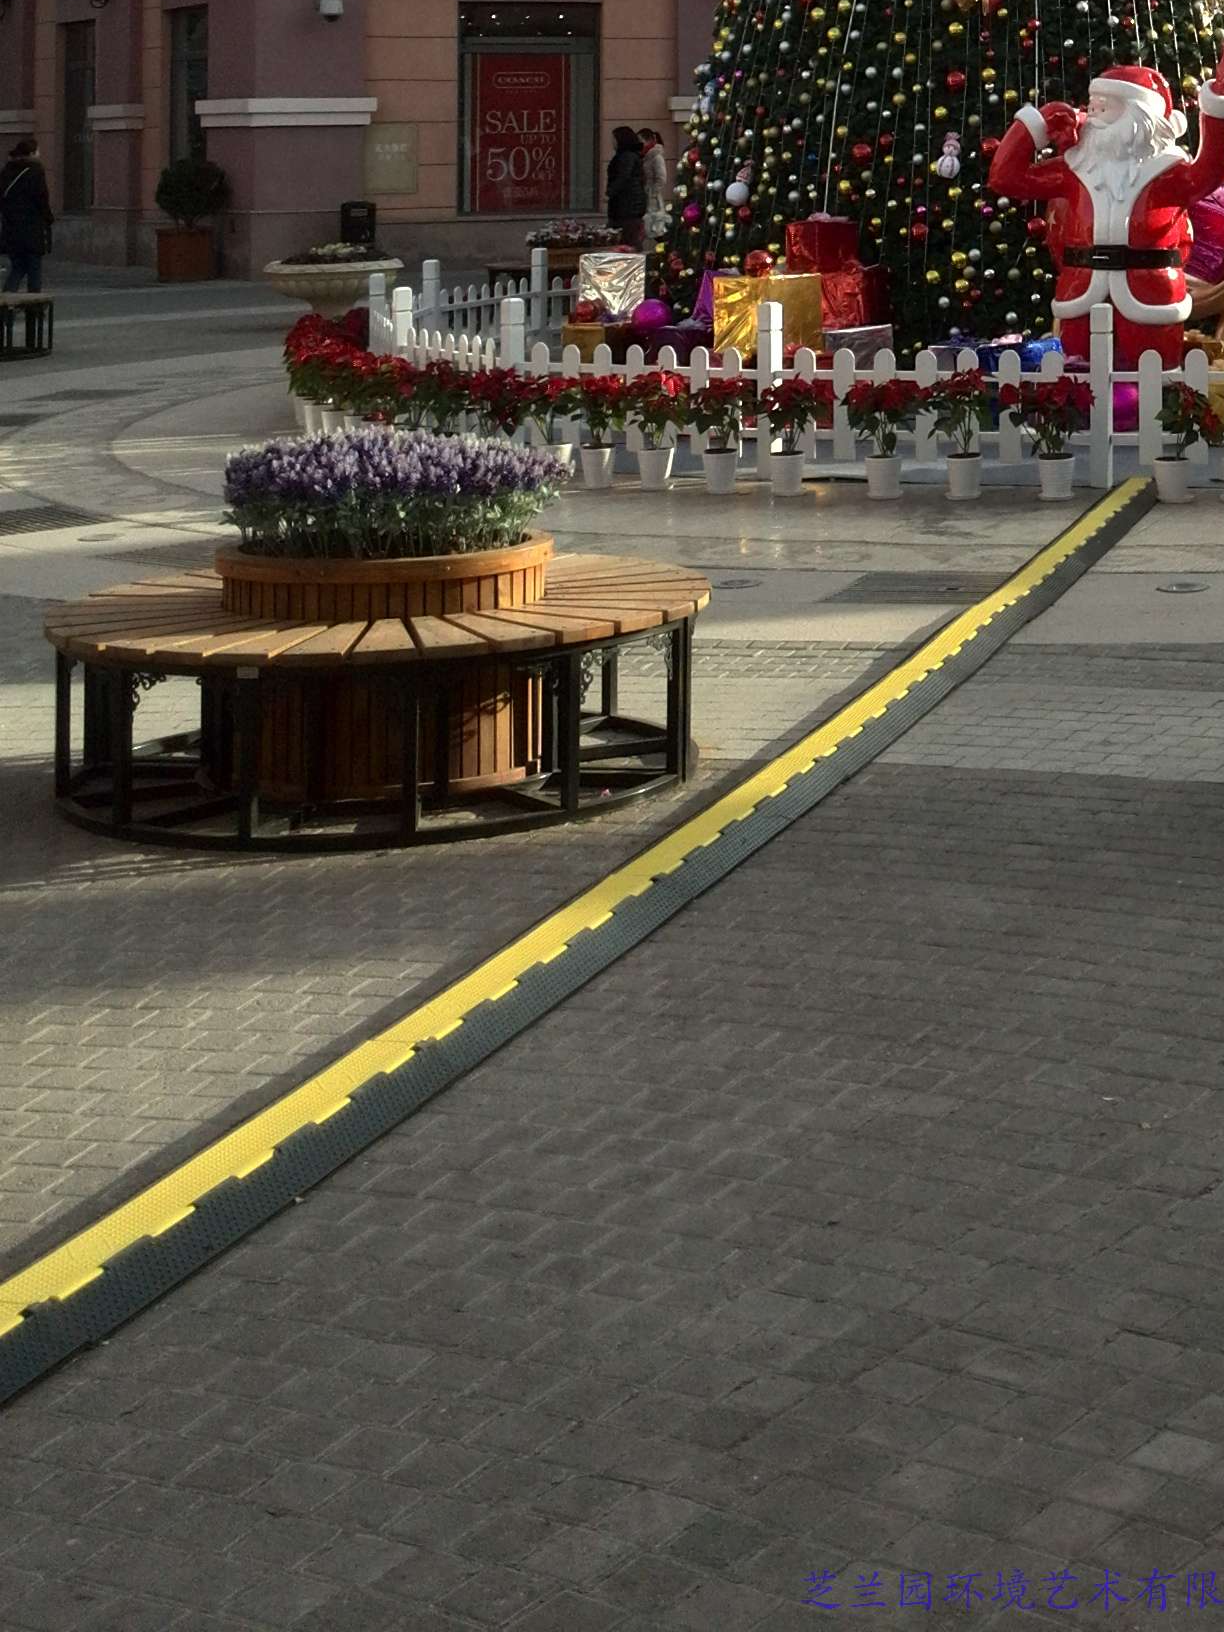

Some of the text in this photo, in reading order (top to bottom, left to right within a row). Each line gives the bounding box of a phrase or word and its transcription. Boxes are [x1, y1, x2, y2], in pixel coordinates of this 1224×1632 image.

[497, 76, 545, 85] COACH
[486, 110, 557, 134] SALE
[486, 146, 556, 181] 50%
